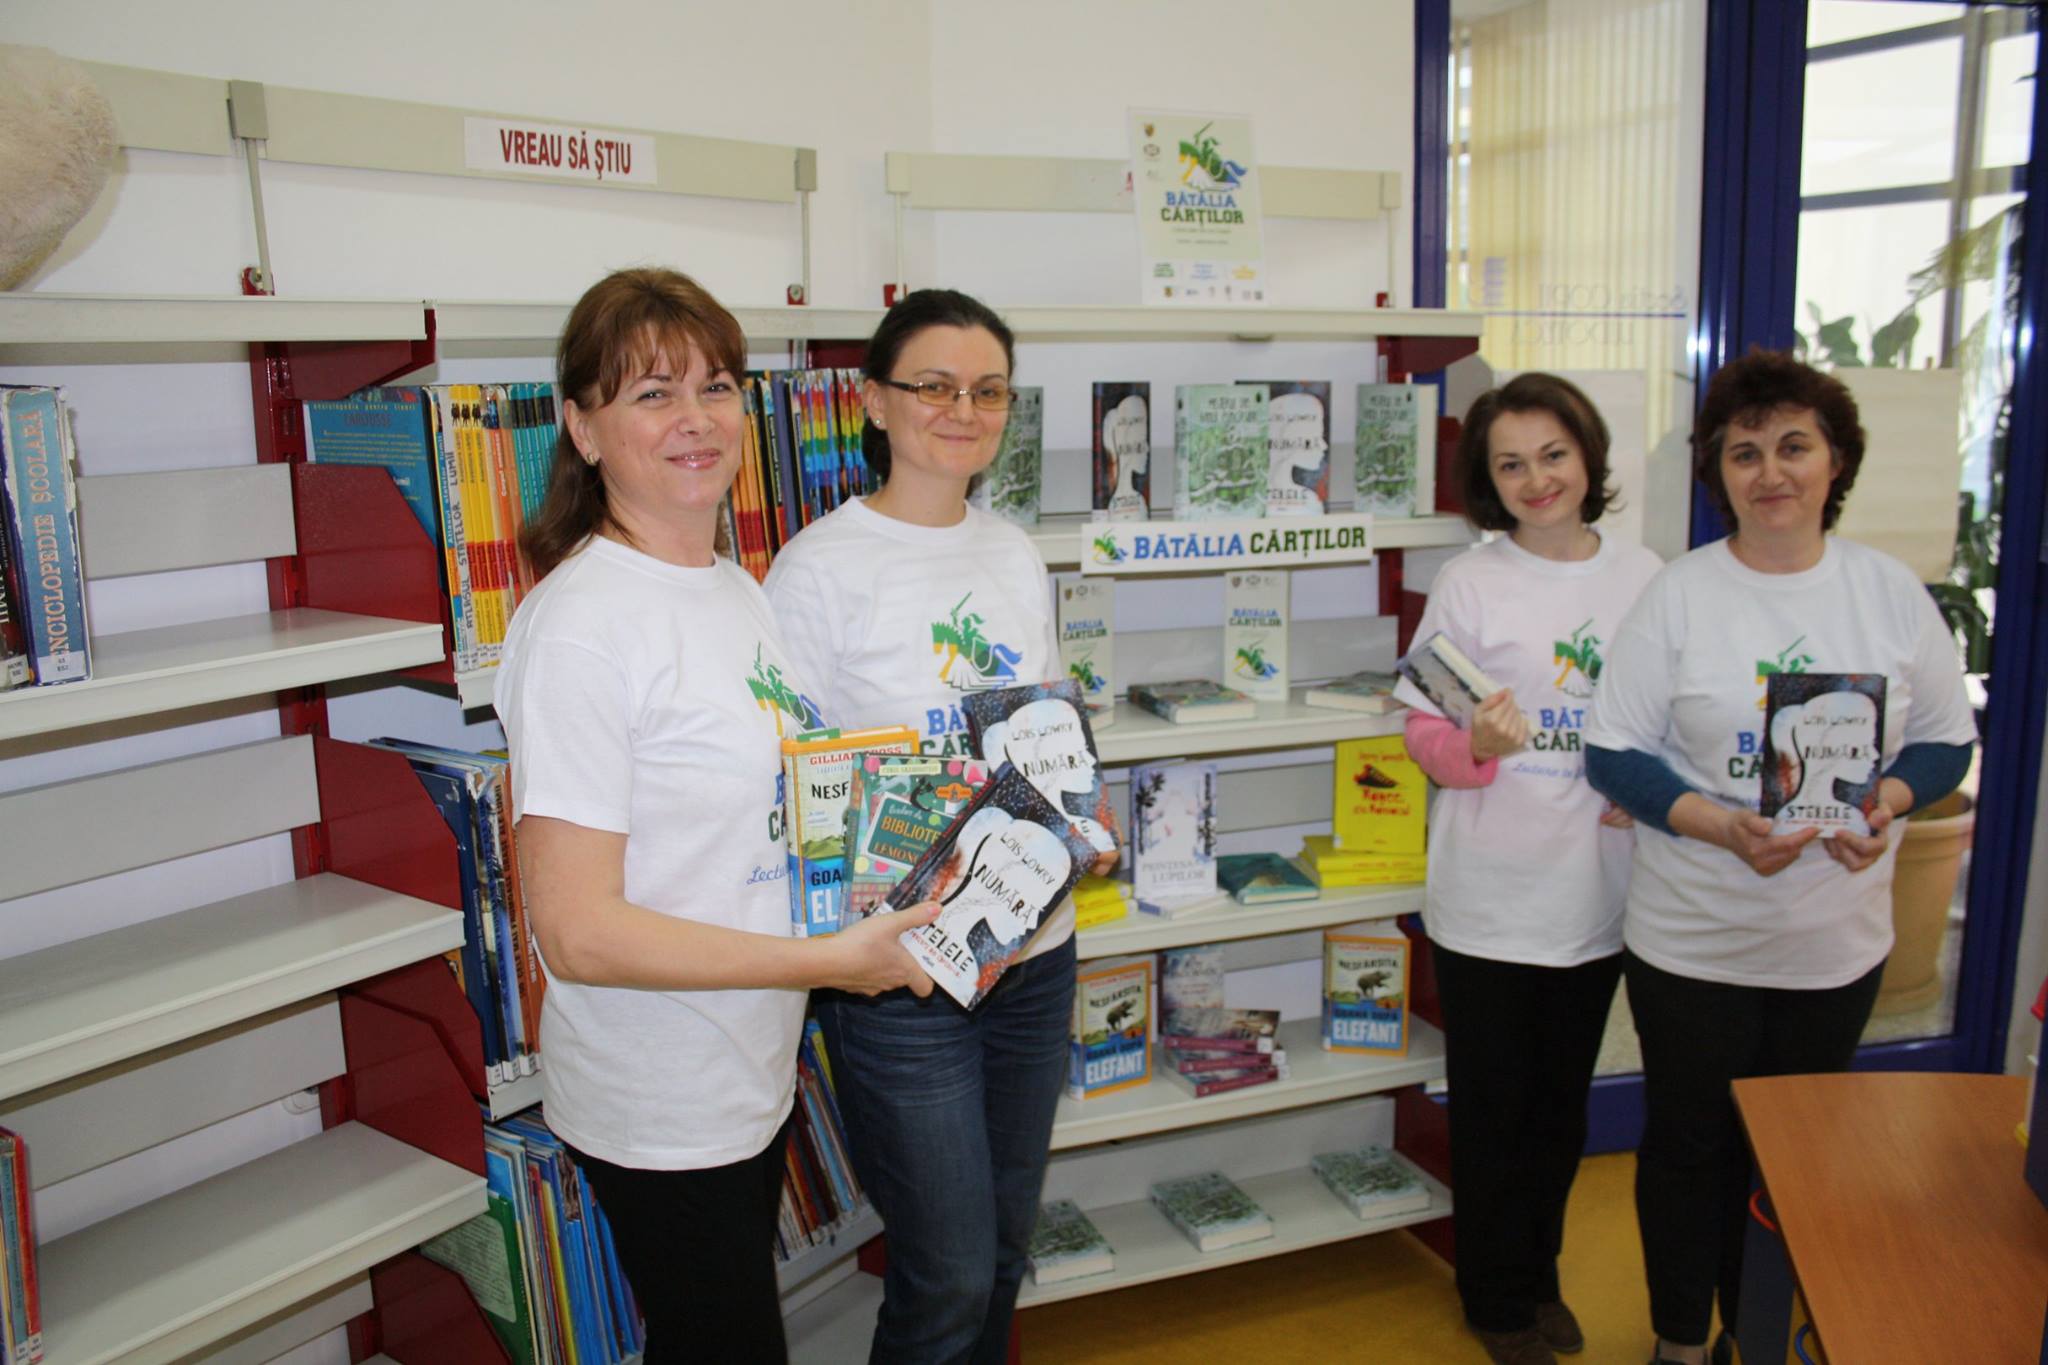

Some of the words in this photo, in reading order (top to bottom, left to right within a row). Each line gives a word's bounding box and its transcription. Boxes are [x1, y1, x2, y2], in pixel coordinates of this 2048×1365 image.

[500, 129, 562, 167] VREAU
[568, 131, 590, 170] SĂ
[1166, 190, 1236, 208] BĂTĂLIA
[1134, 533, 1244, 559] BĂTĂLIA
[1250, 527, 1366, 558] CĂRȚILOR
[1012, 727, 1037, 741] LOIS
[1000, 832, 1023, 857] LOIS
[1021, 854, 1056, 886] LOWRY
[974, 864, 1036, 926] NUMĂRĂ
[921, 923, 974, 972] TELELE
[1333, 1019, 1399, 1043] ELEFANT
[1086, 1049, 1144, 1084] ELEFANT
